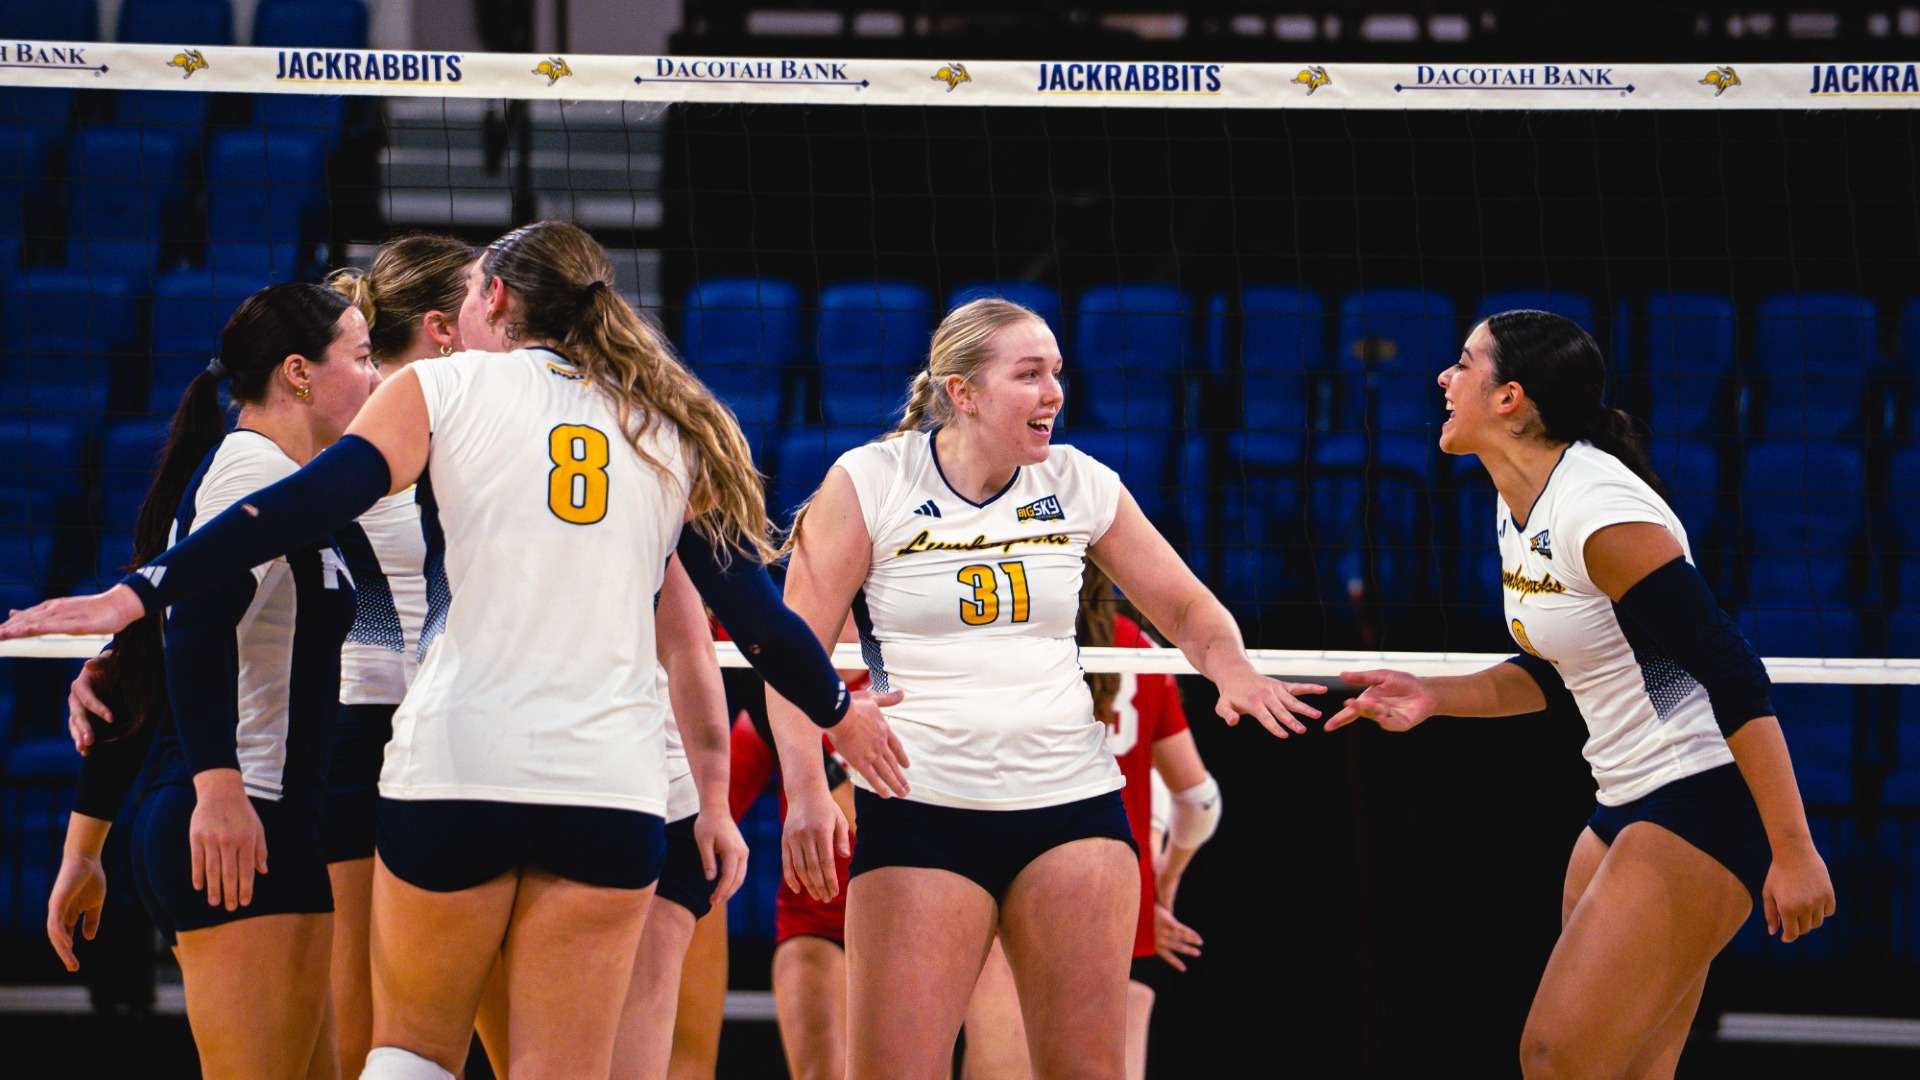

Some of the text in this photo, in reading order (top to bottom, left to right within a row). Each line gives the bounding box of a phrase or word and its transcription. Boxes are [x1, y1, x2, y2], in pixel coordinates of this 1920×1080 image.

[16, 43, 87, 64] BANK
[276, 51, 462, 82] JACKRABBITS
[656, 57, 849, 80] DACOTAH BANK
[1037, 63, 1221, 92] JACKRABBITS
[1417, 65, 1614, 87] DACOTAH BANK
[548, 423, 610, 525] 8
[957, 560, 1031, 627] 31
